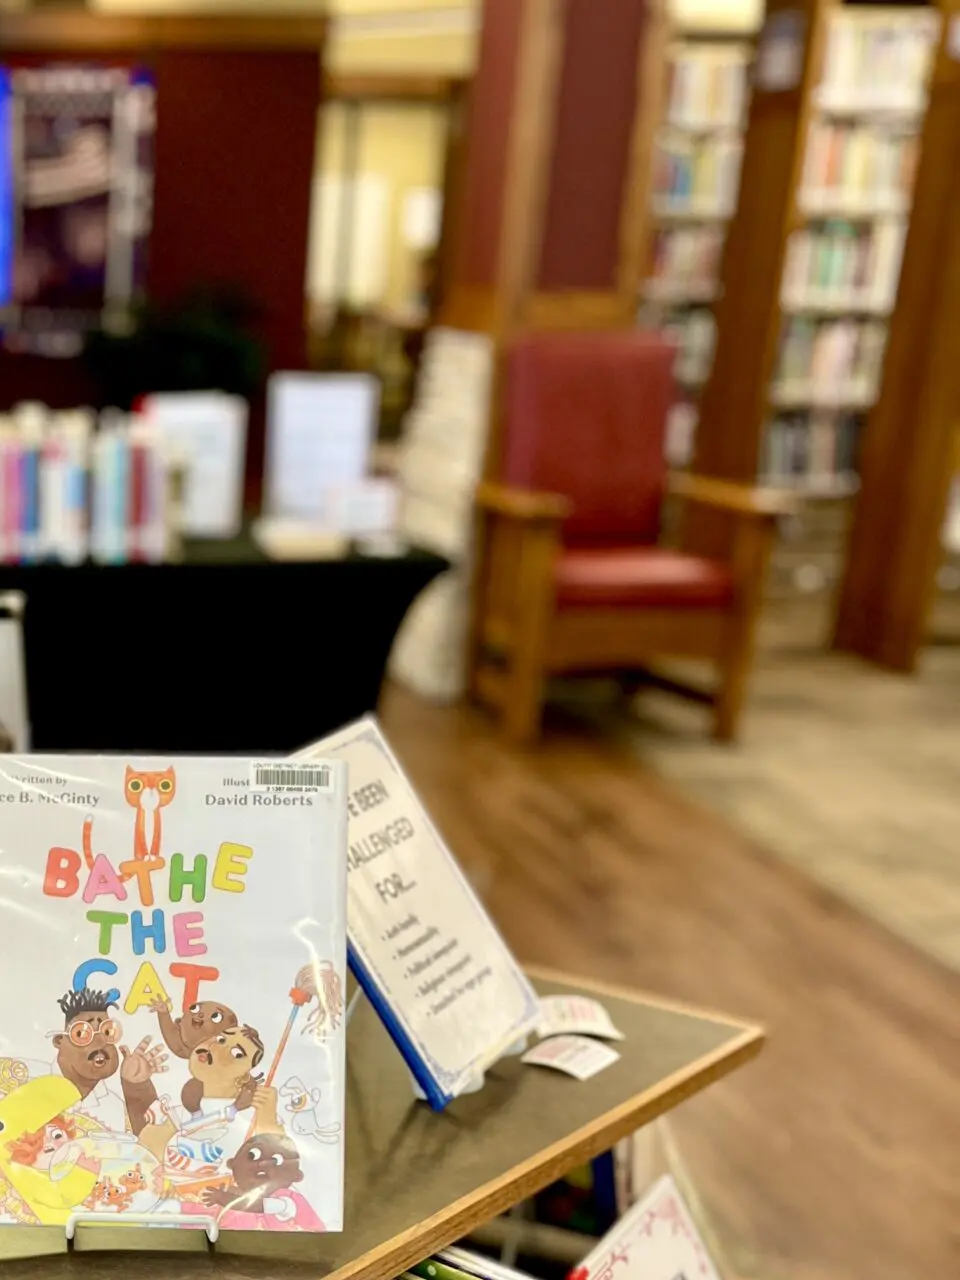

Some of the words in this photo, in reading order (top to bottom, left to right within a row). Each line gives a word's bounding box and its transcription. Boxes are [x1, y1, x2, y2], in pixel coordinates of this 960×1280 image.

[55, 775, 68, 787] by
[19, 791, 33, 803] B.
[38, 792, 100, 807] McGinty
[205, 794, 248, 806] David
[253, 794, 313, 806] Roberts
[43, 842, 254, 907] BATHE
[86, 908, 208, 957] THE
[72, 958, 219, 1015] CAT
